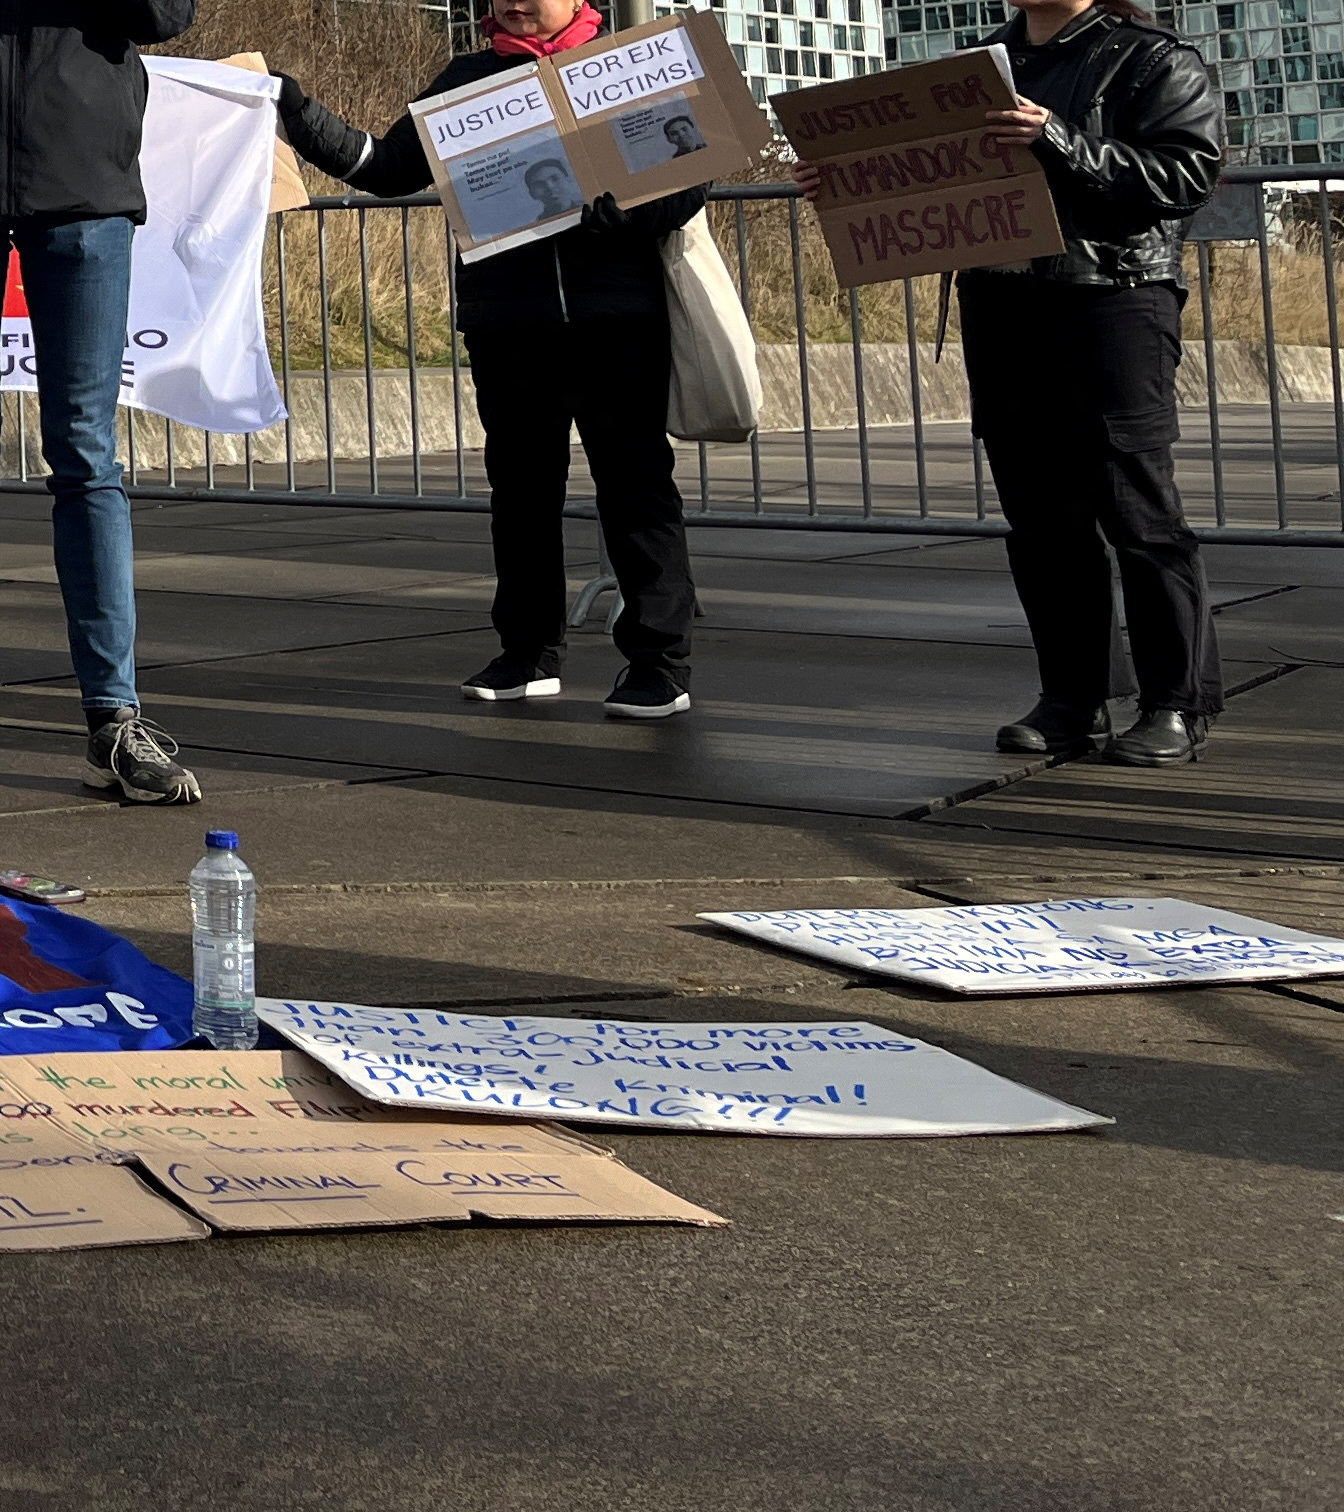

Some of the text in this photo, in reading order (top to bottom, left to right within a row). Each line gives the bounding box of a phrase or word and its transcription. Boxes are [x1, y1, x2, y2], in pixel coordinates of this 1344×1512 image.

[565, 36, 675, 86] FOR EJK
[573, 59, 697, 111] VICTIMS!
[438, 90, 544, 145] JUSTICE
[796, 73, 993, 142] JUSTICE FOR
[816, 137, 984, 199] TUMANDOK
[847, 189, 1032, 266] MASSACRE
[1132, 924, 1242, 945] MGA
[1060, 946, 1128, 962] NG
[262, 1001, 537, 1032] JUSTICE
[708, 1026, 865, 1039] more
[36, 1065, 114, 1090] the
[131, 1064, 244, 1091] moral
[258, 1075, 333, 1090] univ
[365, 1065, 576, 1094] Duterte
[67, 1099, 259, 1120] murdered
[435, 1138, 529, 1153] the
[396, 1159, 570, 1188] COURT
